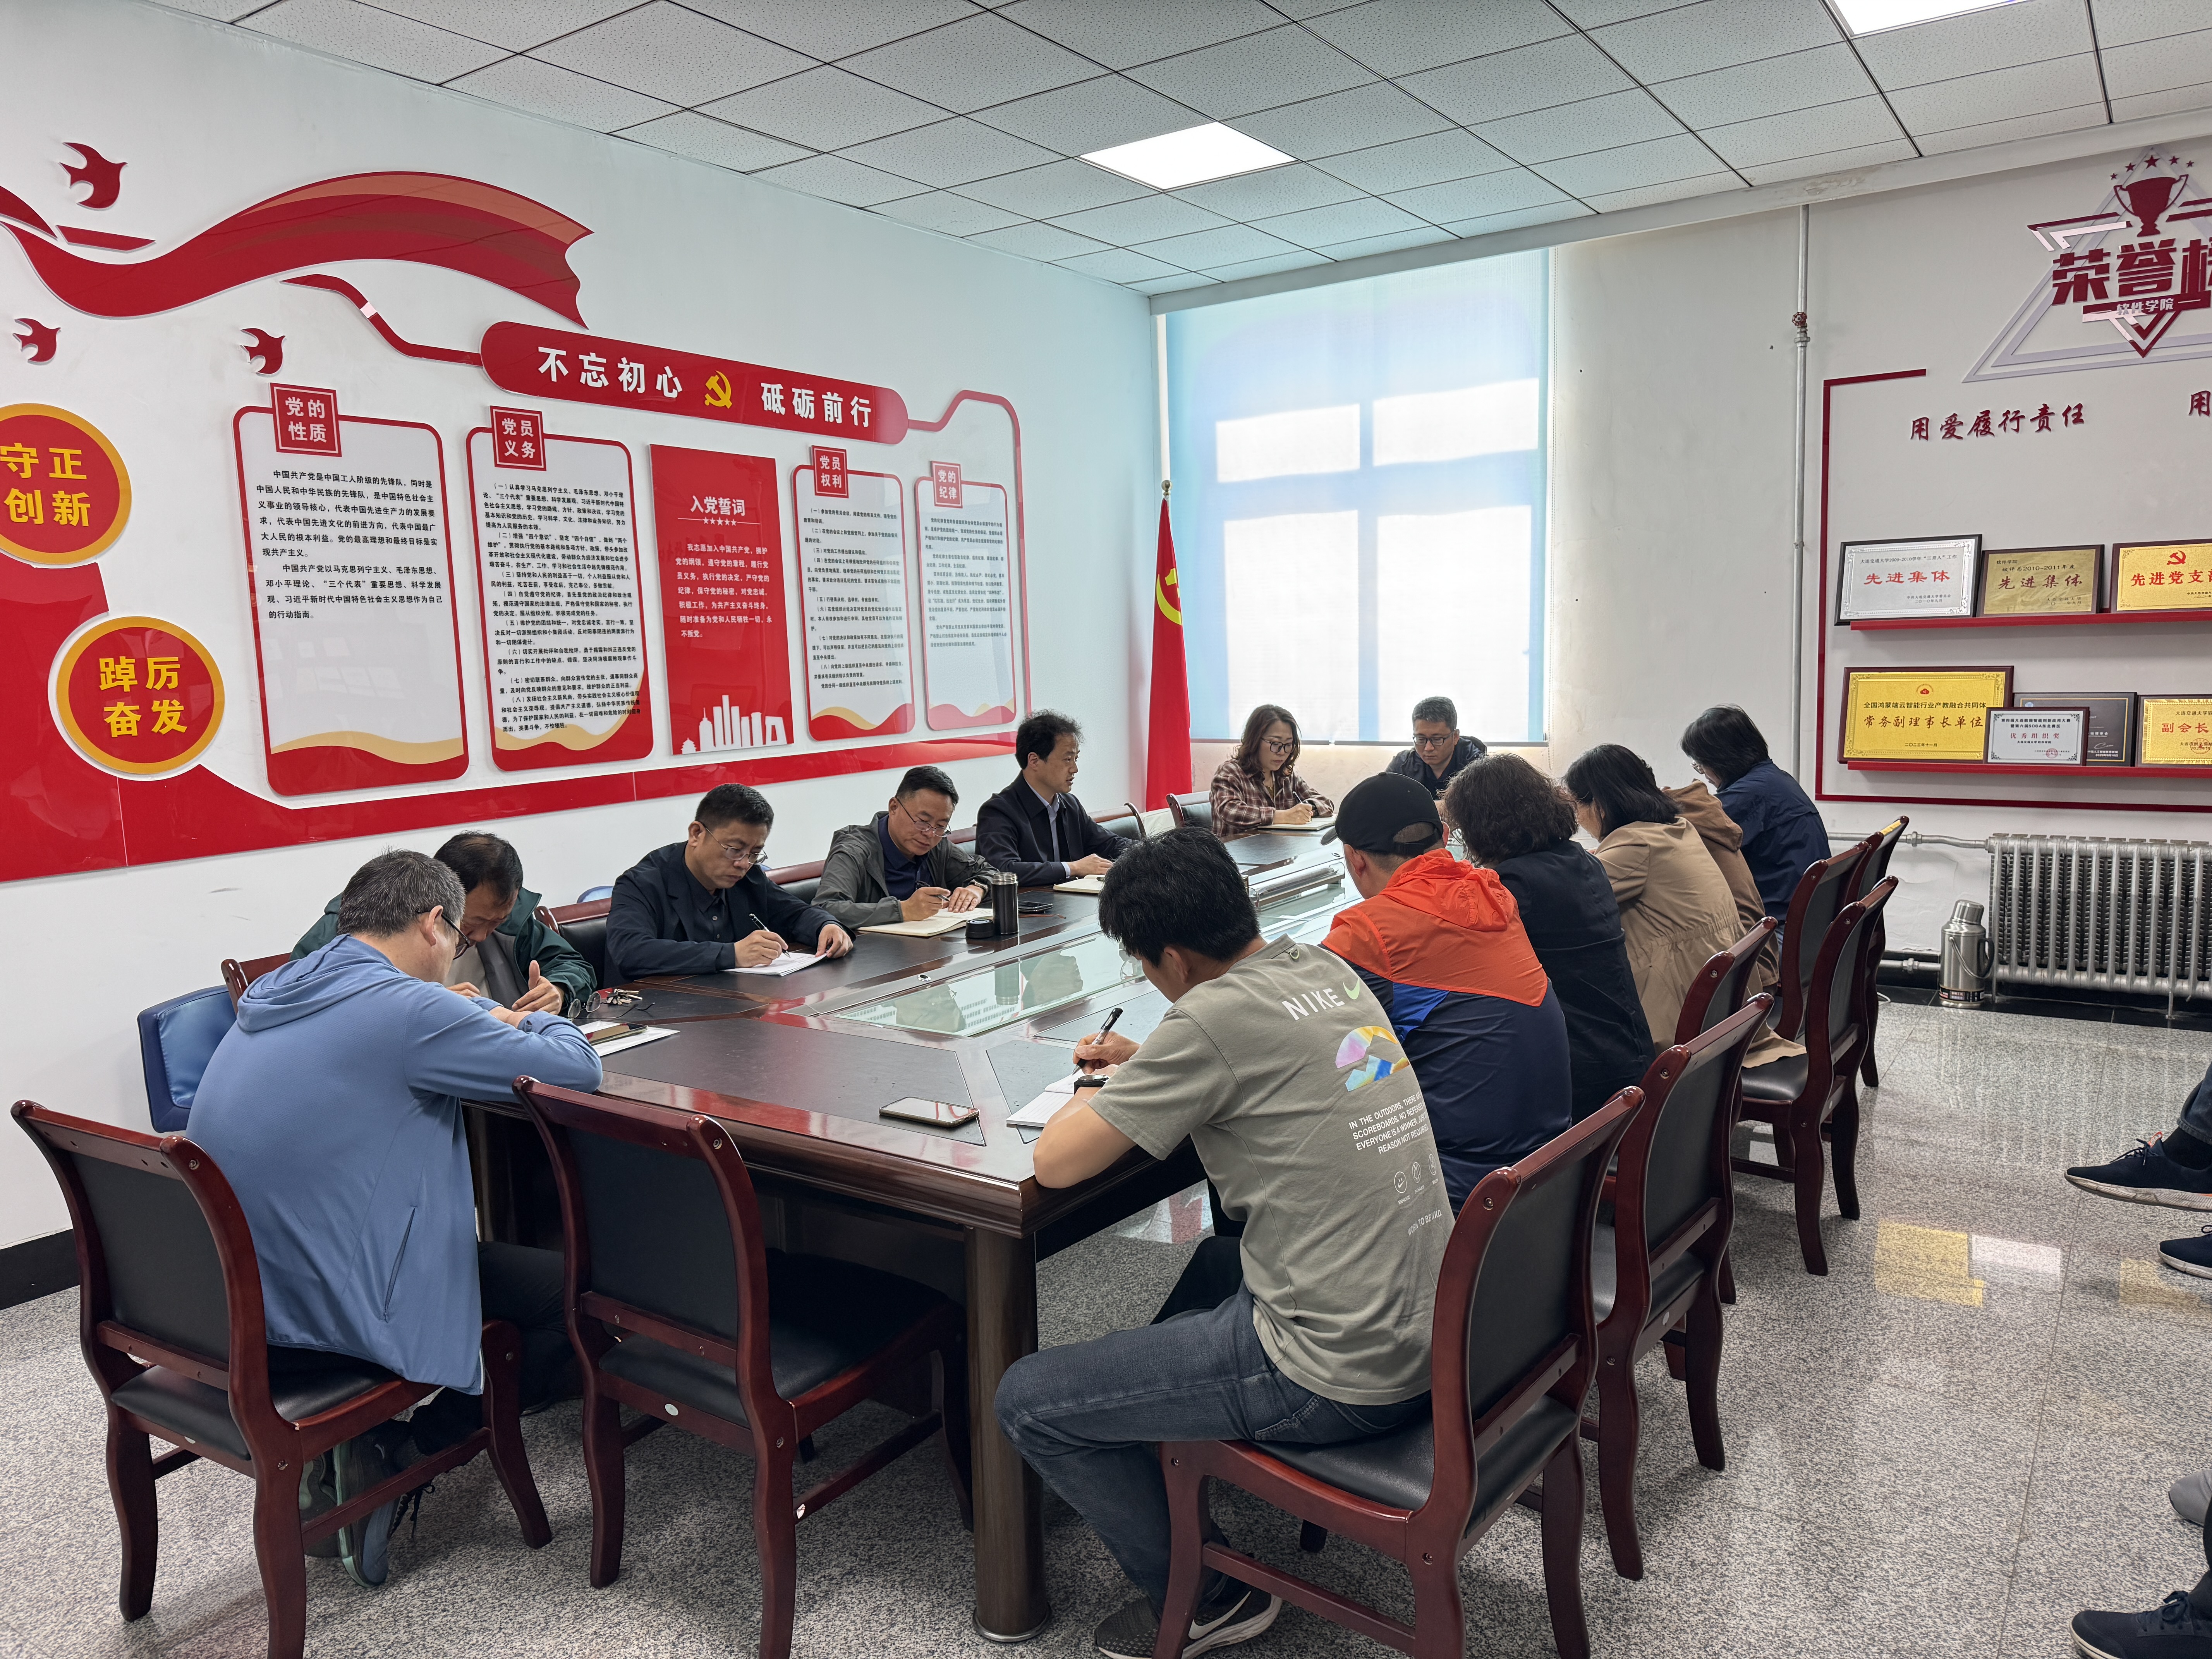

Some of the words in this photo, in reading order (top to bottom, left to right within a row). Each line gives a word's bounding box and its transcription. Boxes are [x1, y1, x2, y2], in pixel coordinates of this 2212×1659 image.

[2116, 298, 2174, 315] 软件学院
[538, 346, 682, 398] 不忘初心
[285, 397, 325, 419] 党的
[761, 382, 871, 427] 砥砺前行
[2188, 390, 2211, 417] 用
[502, 417, 534, 437] 党员
[1910, 402, 2085, 442] 用爱履行责任
[288, 421, 327, 443] 性质
[504, 440, 535, 459] 义务
[0, 443, 87, 480] 守正
[819, 455, 841, 471] 党员
[273, 470, 432, 488] 中国共产党是中国工人阶级的先锋队，同时是
[821, 473, 842, 488] 权利
[938, 469, 956, 484] 党的
[256, 485, 434, 503] 中国人民和中华民族的先锋队，是中国特色社会主
[939, 486, 957, 499] 纪律
[5, 488, 91, 528] 创新
[258, 501, 435, 517] 义事业的领导核心，代表中国先进生产力的发展要
[690, 495, 745, 516] 入党誓词
[260, 517, 436, 531] 求，代表中国先进文化的前进方向，代表中国最广
[261, 532, 437, 546] 大人民的根本利益。党的最高理想和最终目标是实
[262, 548, 308, 557] 现共产主义。
[282, 564, 436, 574] 中国共产党以马克思列宁主义、毛泽东思想、
[1863, 570, 1950, 585] 先进集体
[1998, 574, 2082, 589] 先进集体
[267, 595, 443, 603] 观、习近平新时代中国特色社会主义思想作为自己
[269, 611, 314, 619] 的行动指南。
[99, 656, 180, 692] 踔厉
[103, 700, 188, 738] 奋发
[1864, 715, 1983, 729] 常务副理事长单位
[2162, 723, 2212, 733] 副会长
[1281, 988, 1345, 1020] NIKE
[1348, 1120, 1358, 1130] IN
[1358, 1115, 1373, 1125] THE
[1374, 1102, 1403, 1120] OUTDOORS,
[1403, 1095, 1416, 1106] THERE
[1353, 1116, 1400, 1140] SCOREBOARDS,
[1399, 1111, 1407, 1121] NO
[1356, 1131, 1392, 1151] EVERYONE
[1391, 1128, 1397, 1137] IS
[1400, 1118, 1419, 1131] WINNER.
[1378, 1137, 1401, 1154] REASON
[1401, 1133, 1410, 1144] NOT
[1418, 1217, 1425, 1226] TO
[1425, 1215, 1431, 1223] BE
